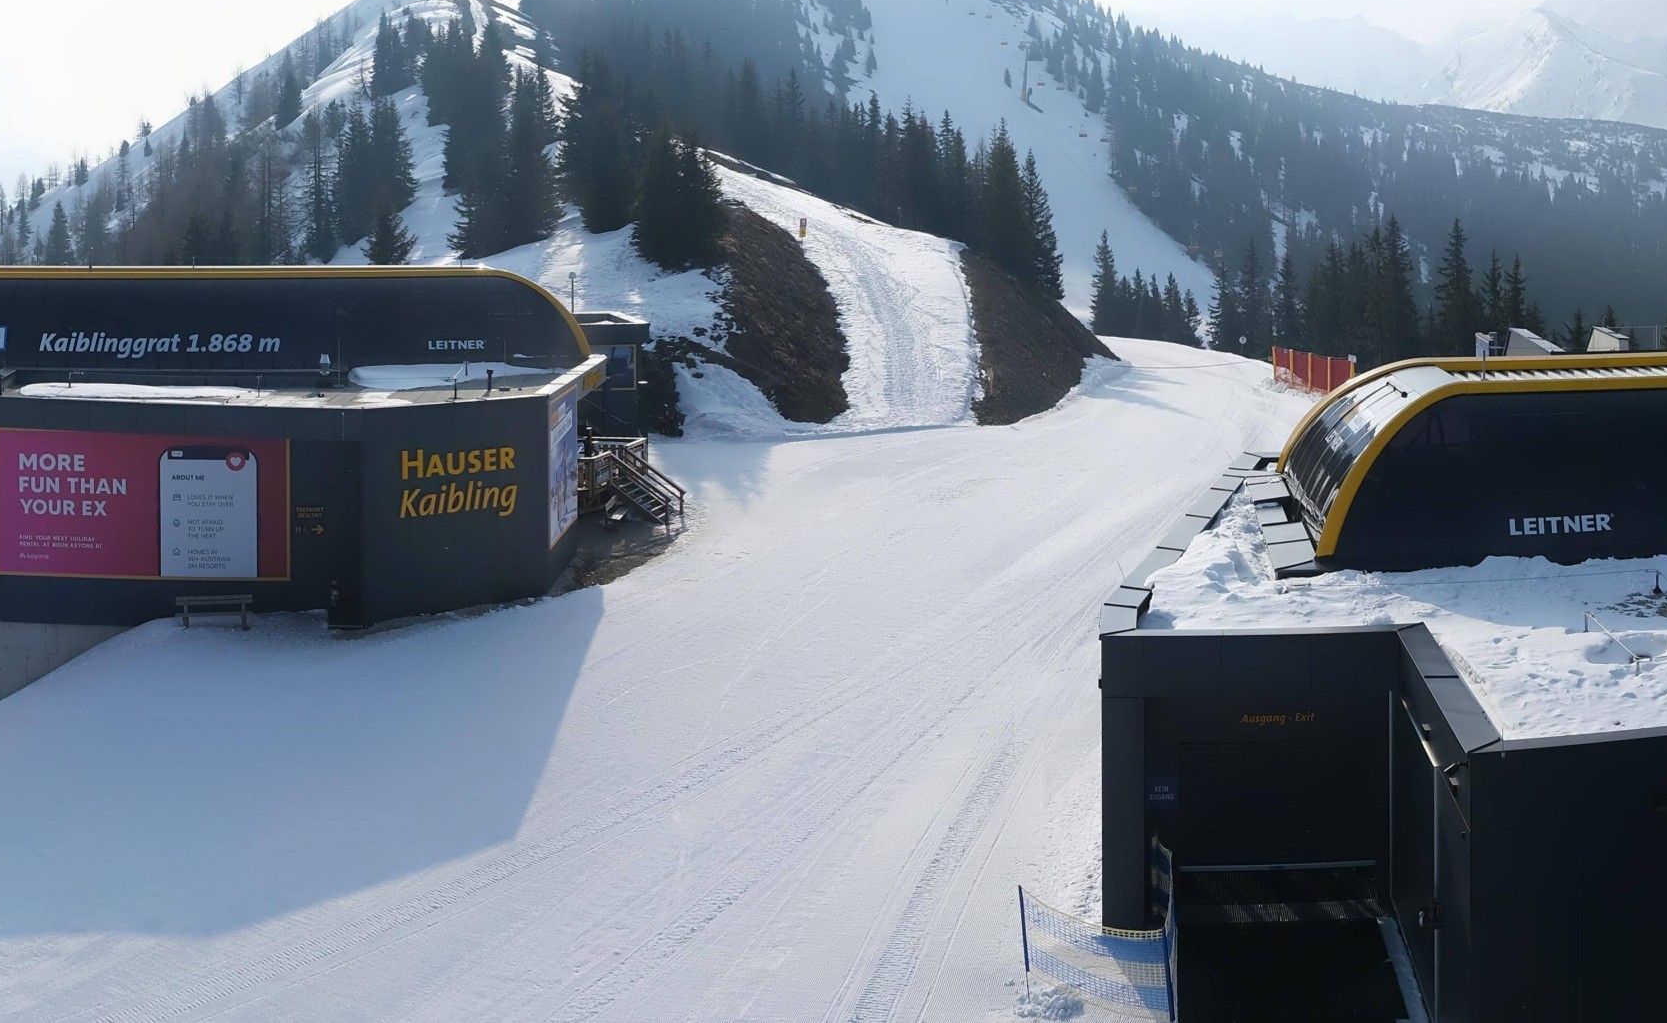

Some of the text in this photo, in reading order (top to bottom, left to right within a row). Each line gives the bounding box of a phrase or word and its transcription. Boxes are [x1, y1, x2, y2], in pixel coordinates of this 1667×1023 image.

[38, 332, 281, 359] Kaiblinggrat 1.868 m
[427, 339, 486, 350] LEITNER
[19, 453, 85, 472] MORE
[401, 446, 516, 480] HAUSER
[19, 476, 127, 495] FUN THAN
[20, 498, 107, 516] YOUR EX
[400, 480, 518, 518] Kaibling
[1509, 513, 1613, 536] LEITNER
[1240, 713, 1286, 726] Ausgang
[1295, 711, 1316, 722] Exit
